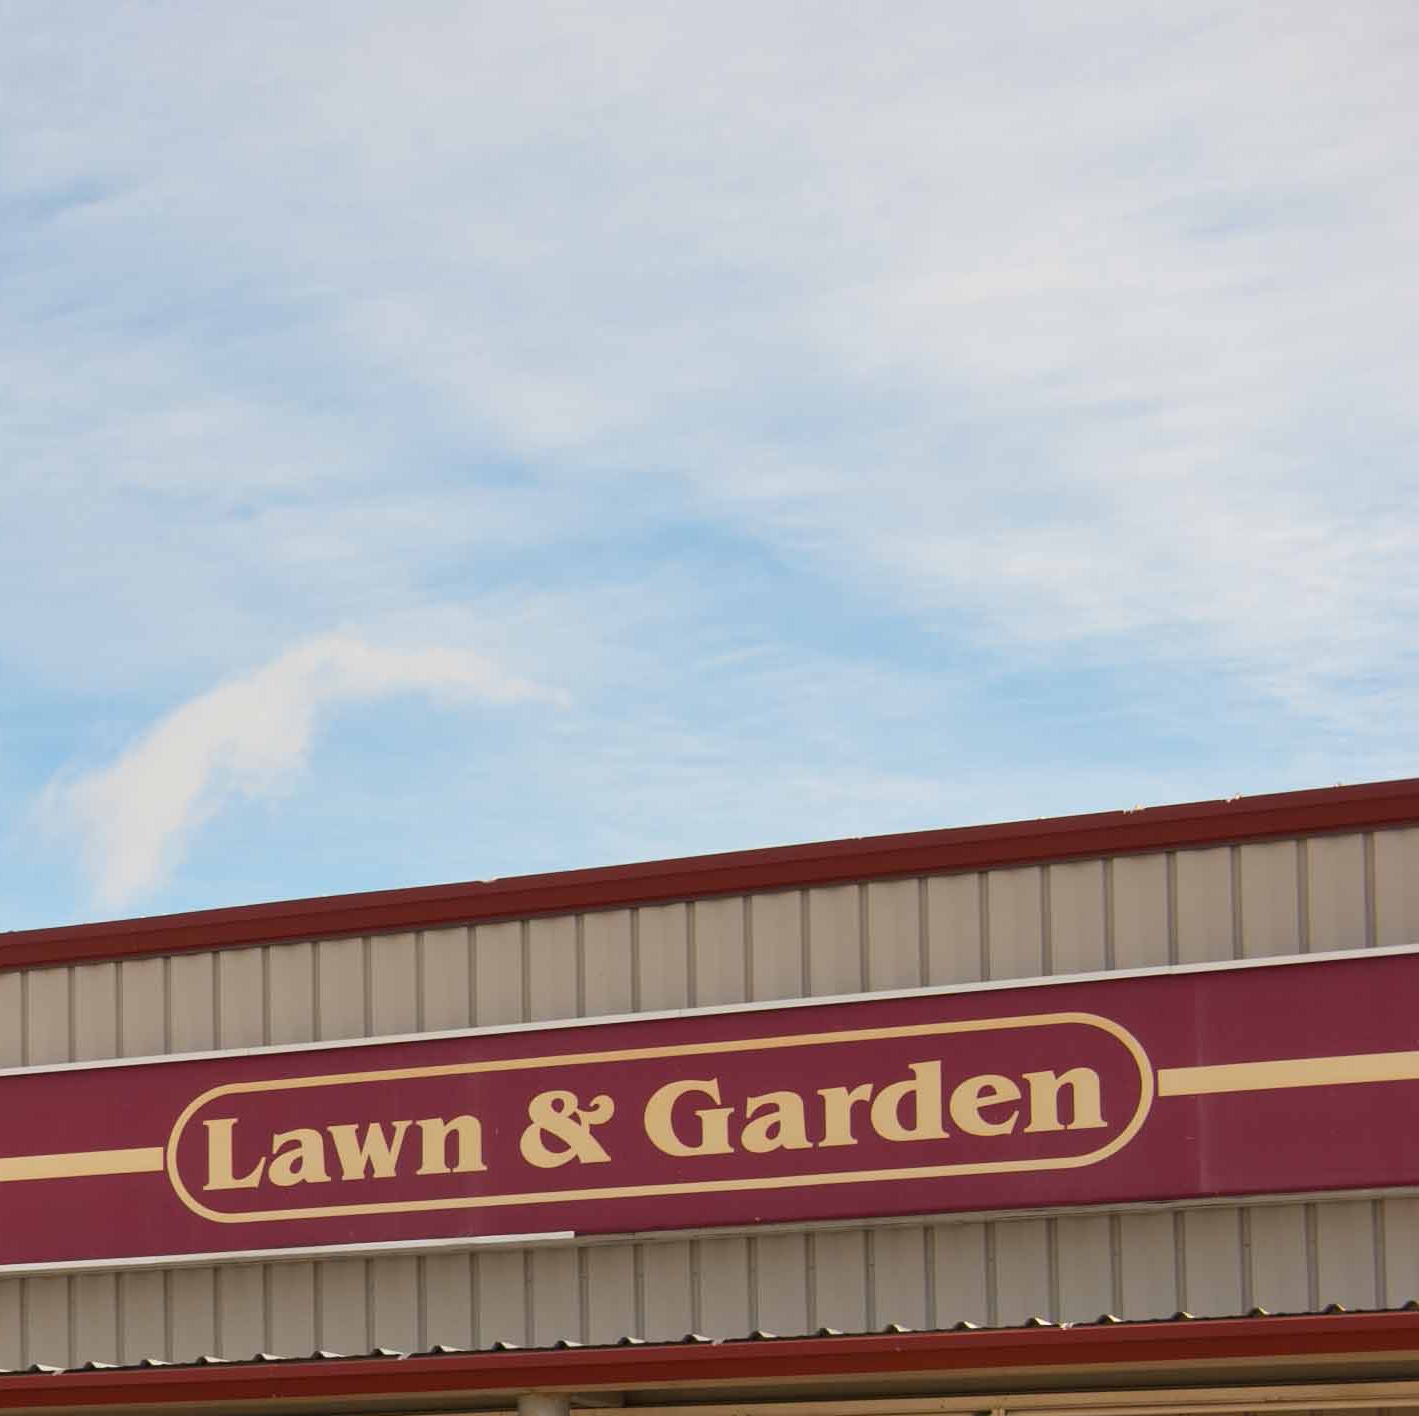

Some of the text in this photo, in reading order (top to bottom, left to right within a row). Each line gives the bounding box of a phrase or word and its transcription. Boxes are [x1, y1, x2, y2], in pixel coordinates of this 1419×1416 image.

[201, 1059, 1109, 1193] Lawn & Garden
